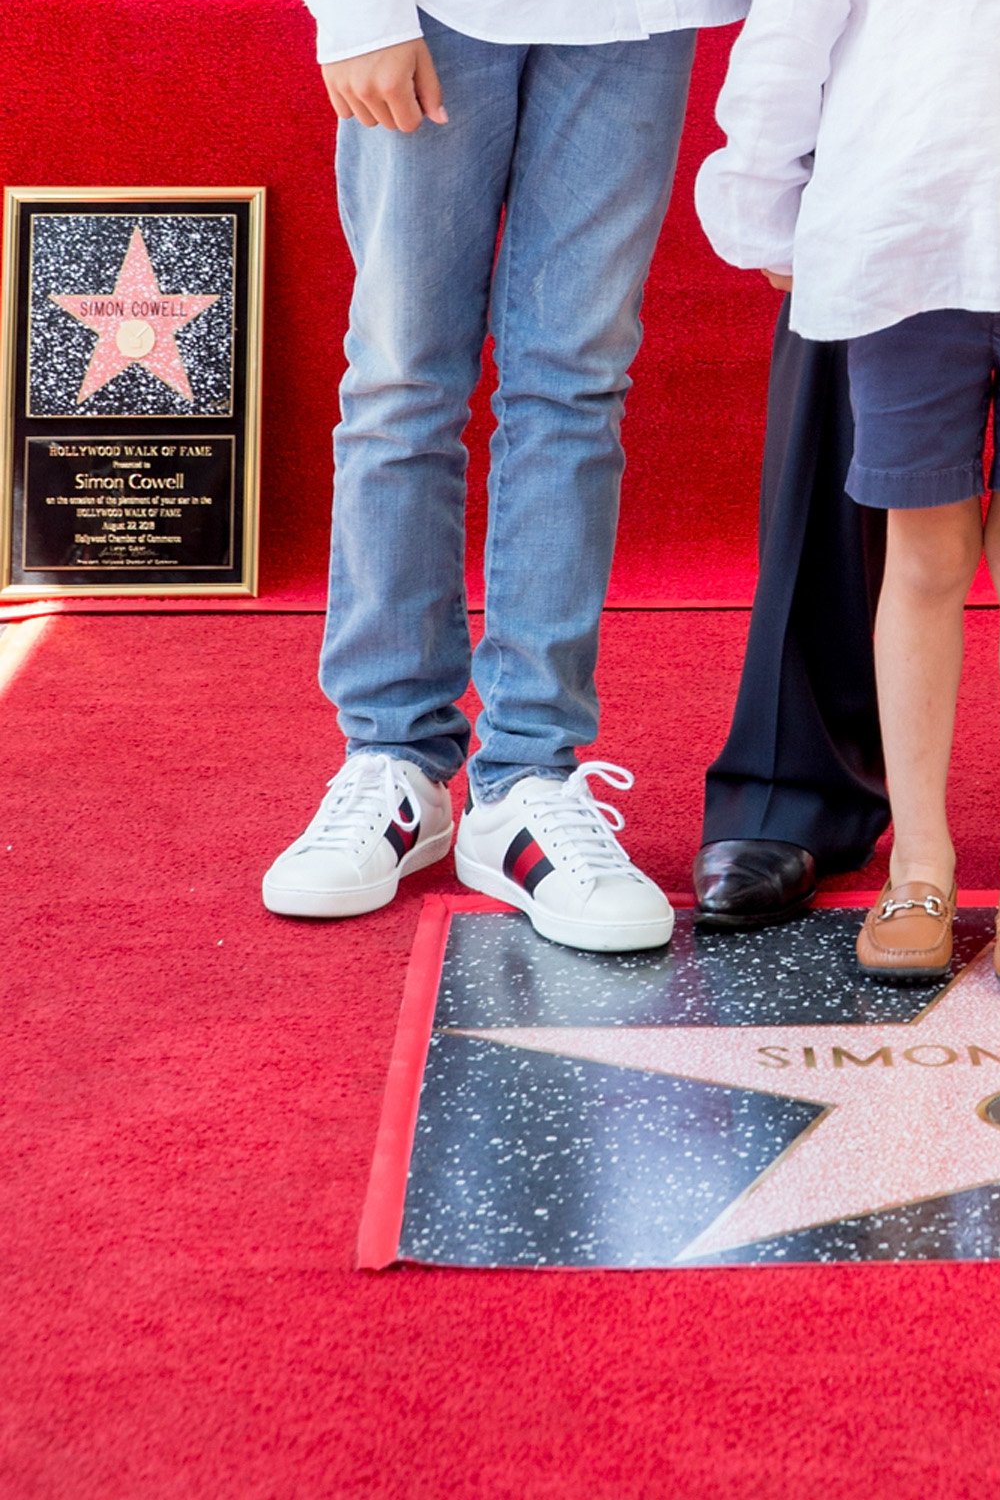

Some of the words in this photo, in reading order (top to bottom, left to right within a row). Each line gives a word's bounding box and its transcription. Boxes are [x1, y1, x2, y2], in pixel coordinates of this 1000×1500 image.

[80, 301, 124, 317] SIMON
[131, 301, 188, 318] COWELL
[49, 446, 120, 457] HOLLYWOOD
[124, 446, 158, 457] WALK
[161, 446, 177, 457] OF
[179, 446, 212, 457] FAME
[75, 473, 124, 489] Simon
[128, 473, 184, 489] Cowell
[76, 508, 122, 517] HOLLYWOOD
[124, 508, 146, 517] WALK
[148, 508, 159, 517] OF
